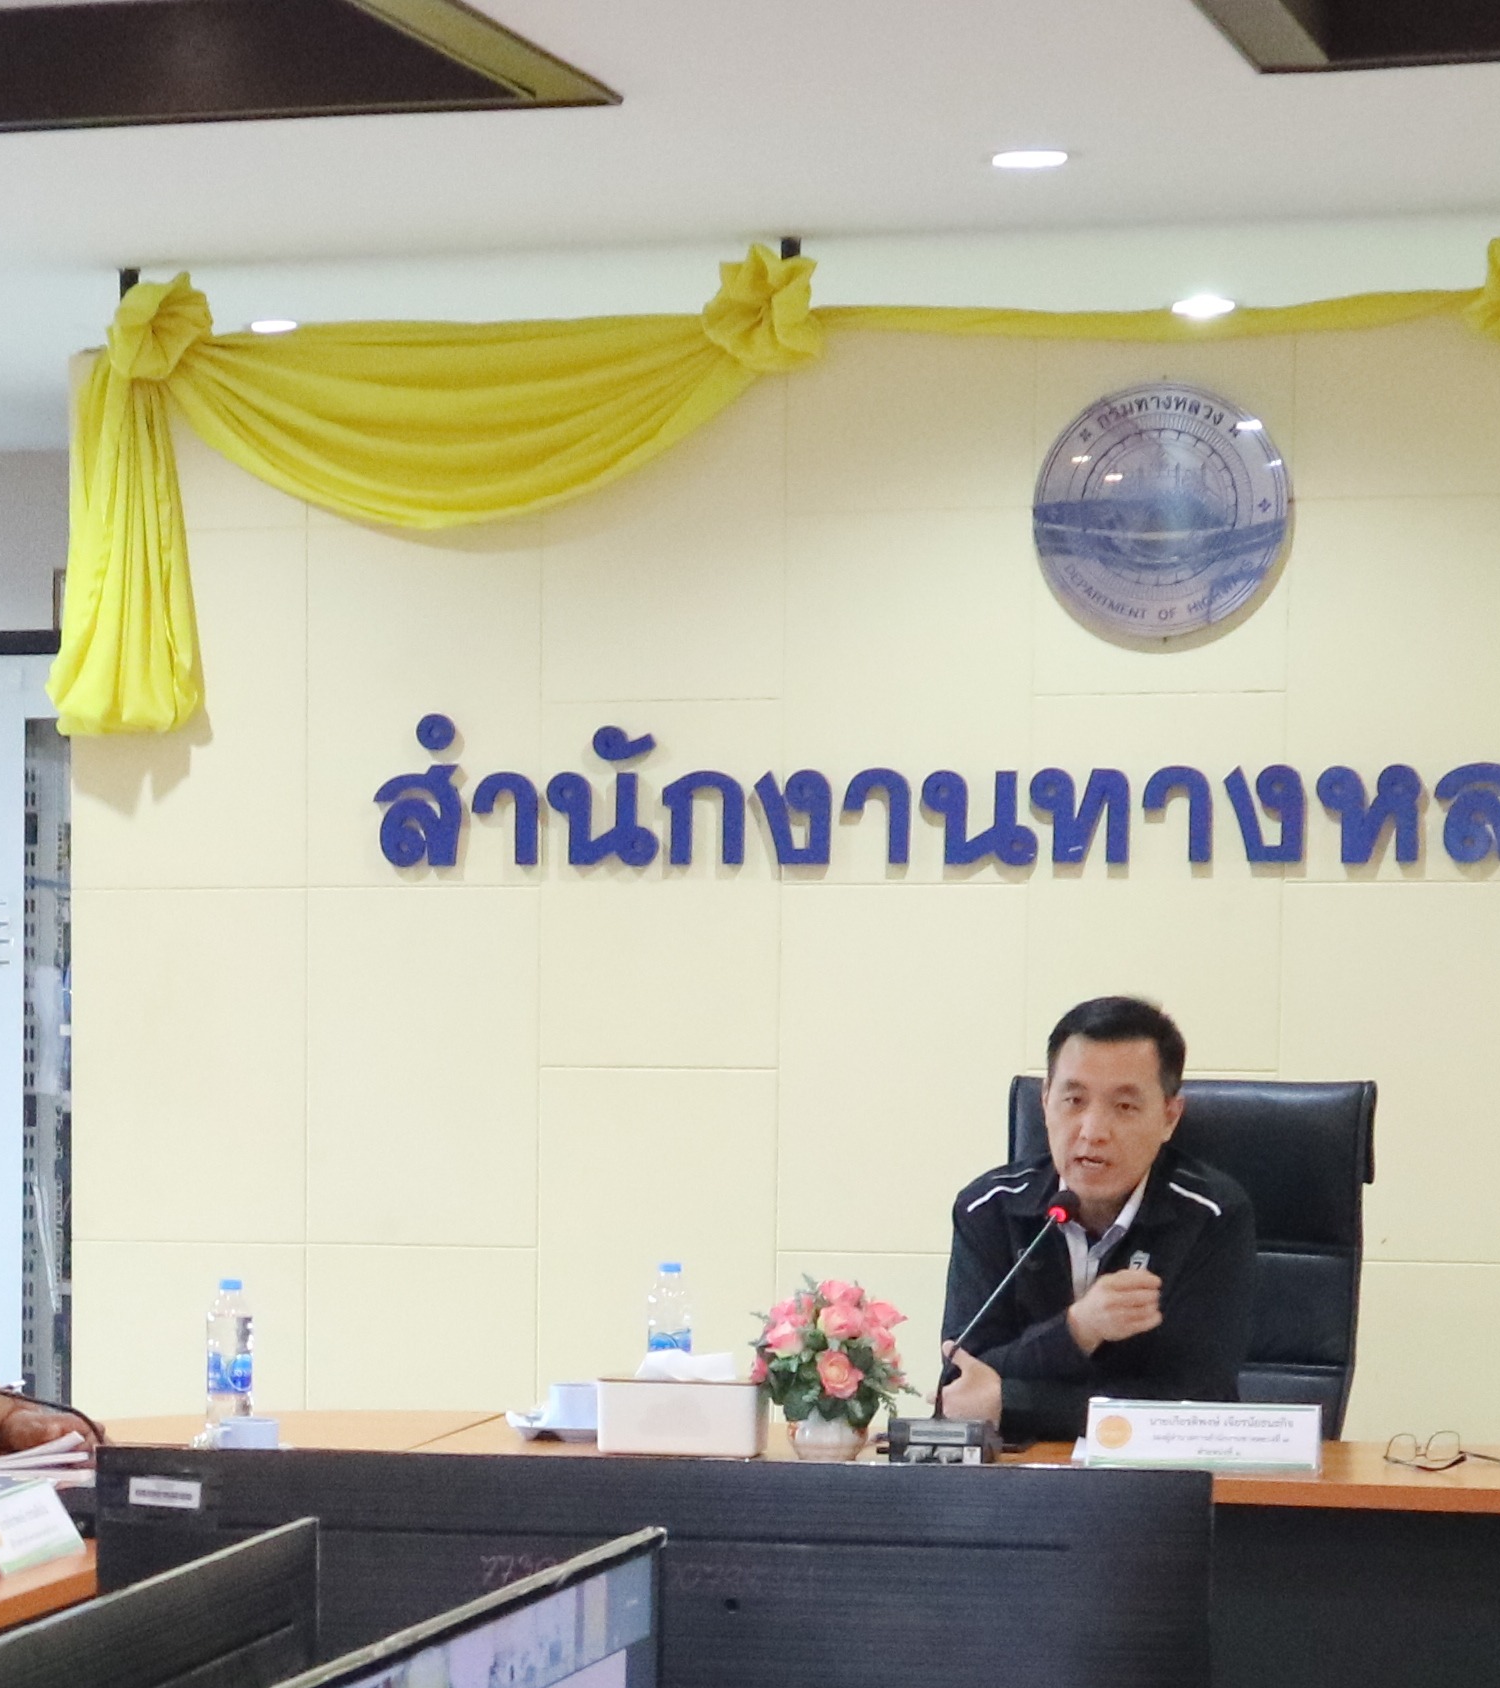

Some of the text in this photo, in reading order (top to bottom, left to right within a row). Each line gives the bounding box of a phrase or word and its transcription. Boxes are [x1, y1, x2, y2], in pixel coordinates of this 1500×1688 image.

[1096, 394, 1224, 429] กรมทางหลวง
[1064, 563, 1148, 620] DEPARTMENT
[1158, 607, 1176, 621] OF
